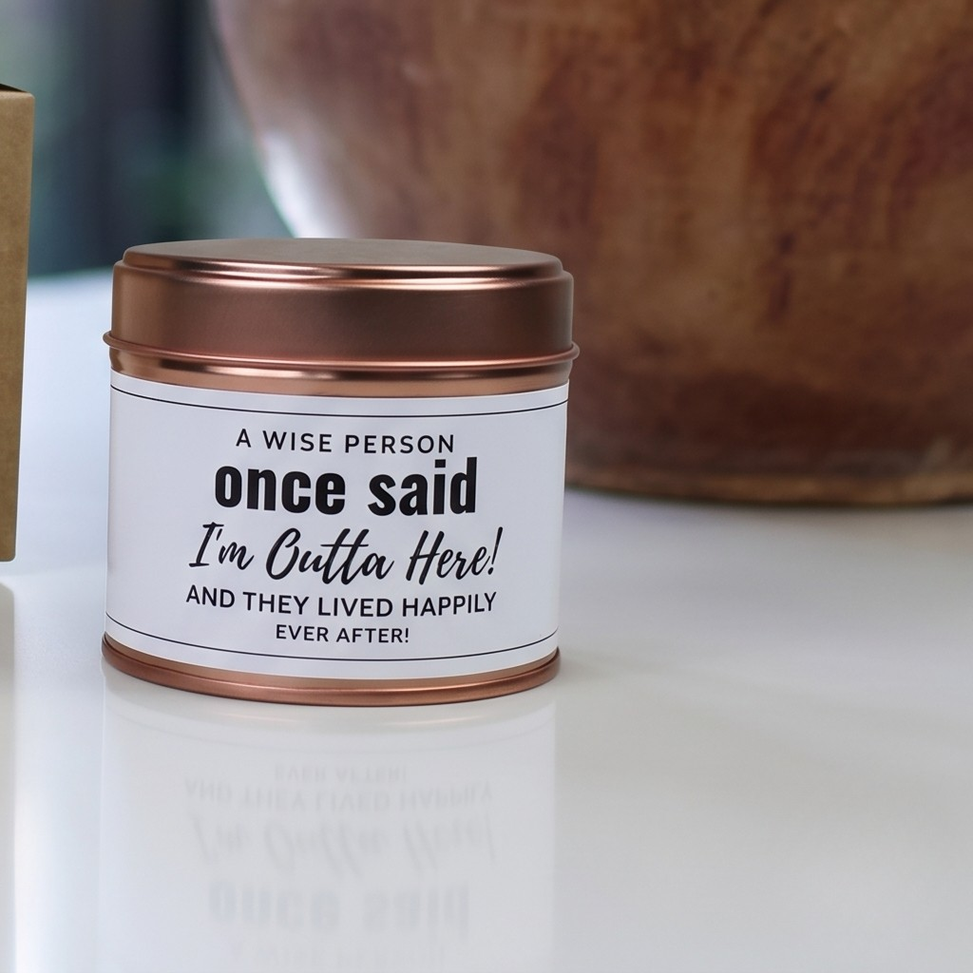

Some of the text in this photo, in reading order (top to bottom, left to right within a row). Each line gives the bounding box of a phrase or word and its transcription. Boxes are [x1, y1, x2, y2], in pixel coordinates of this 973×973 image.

[235, 428, 455, 454] A WISE PERSON
[214, 456, 478, 517] once said
[188, 521, 504, 586] I'm Outta Here!
[185, 584, 498, 618] AND THEY LIVED HAPPILY
[275, 623, 410, 644] EVER AFTER!
